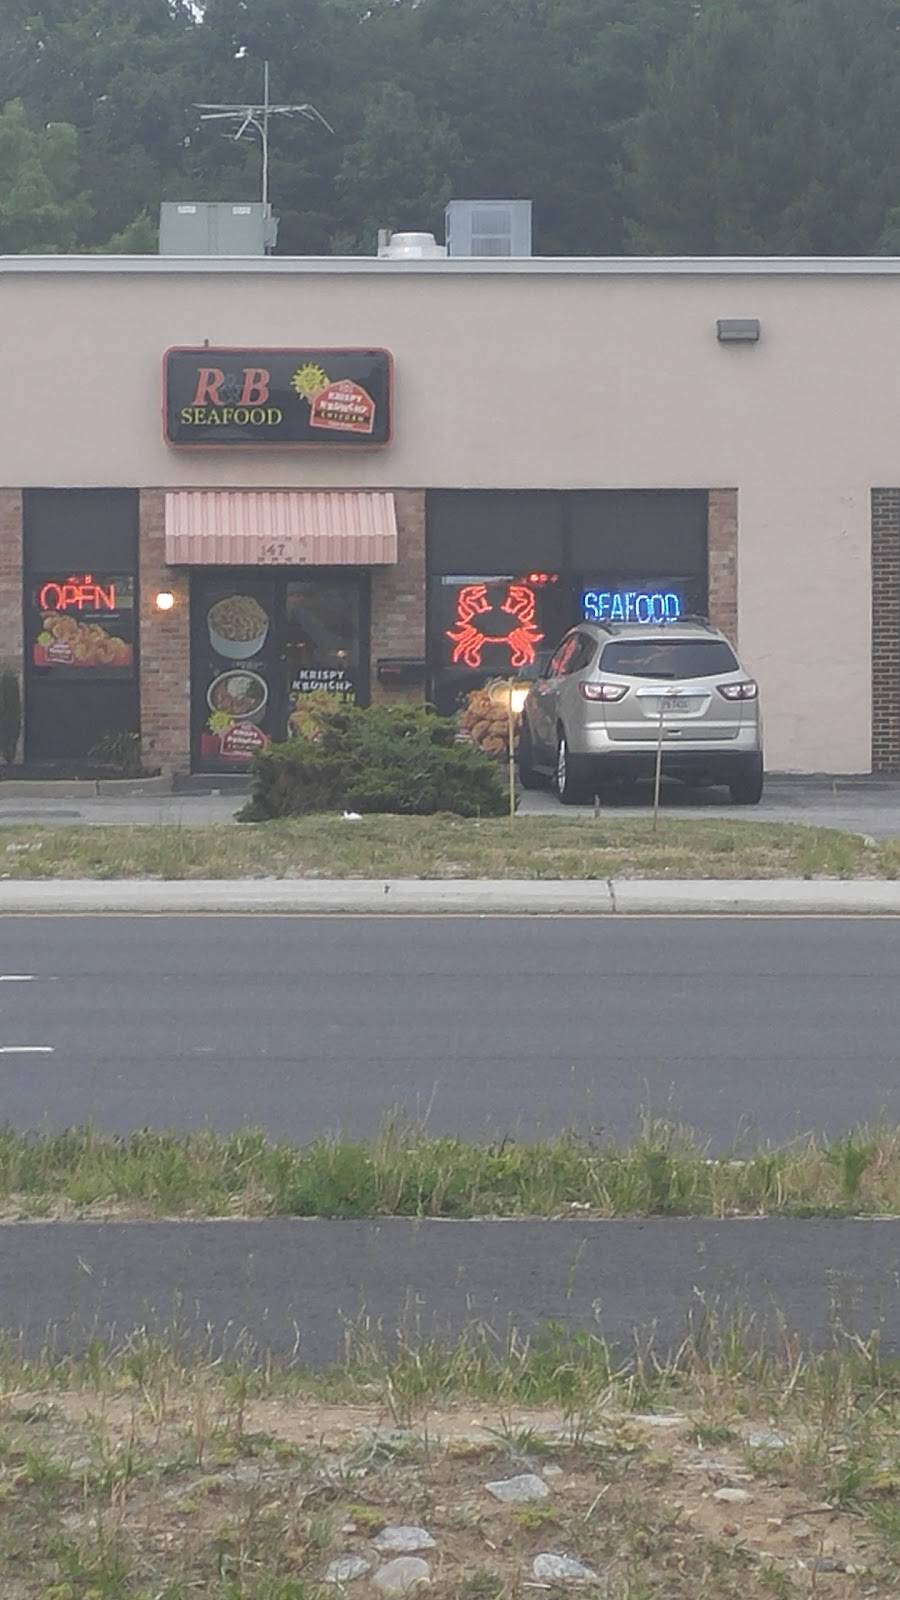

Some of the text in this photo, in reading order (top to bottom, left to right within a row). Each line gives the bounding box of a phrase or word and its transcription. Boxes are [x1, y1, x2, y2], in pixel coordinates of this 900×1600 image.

[180, 407, 283, 426] SEAFOOD
[40, 582, 116, 611] OPEN
[584, 591, 681, 623] SEAFOOD
[299, 670, 345, 680] KRISPY
